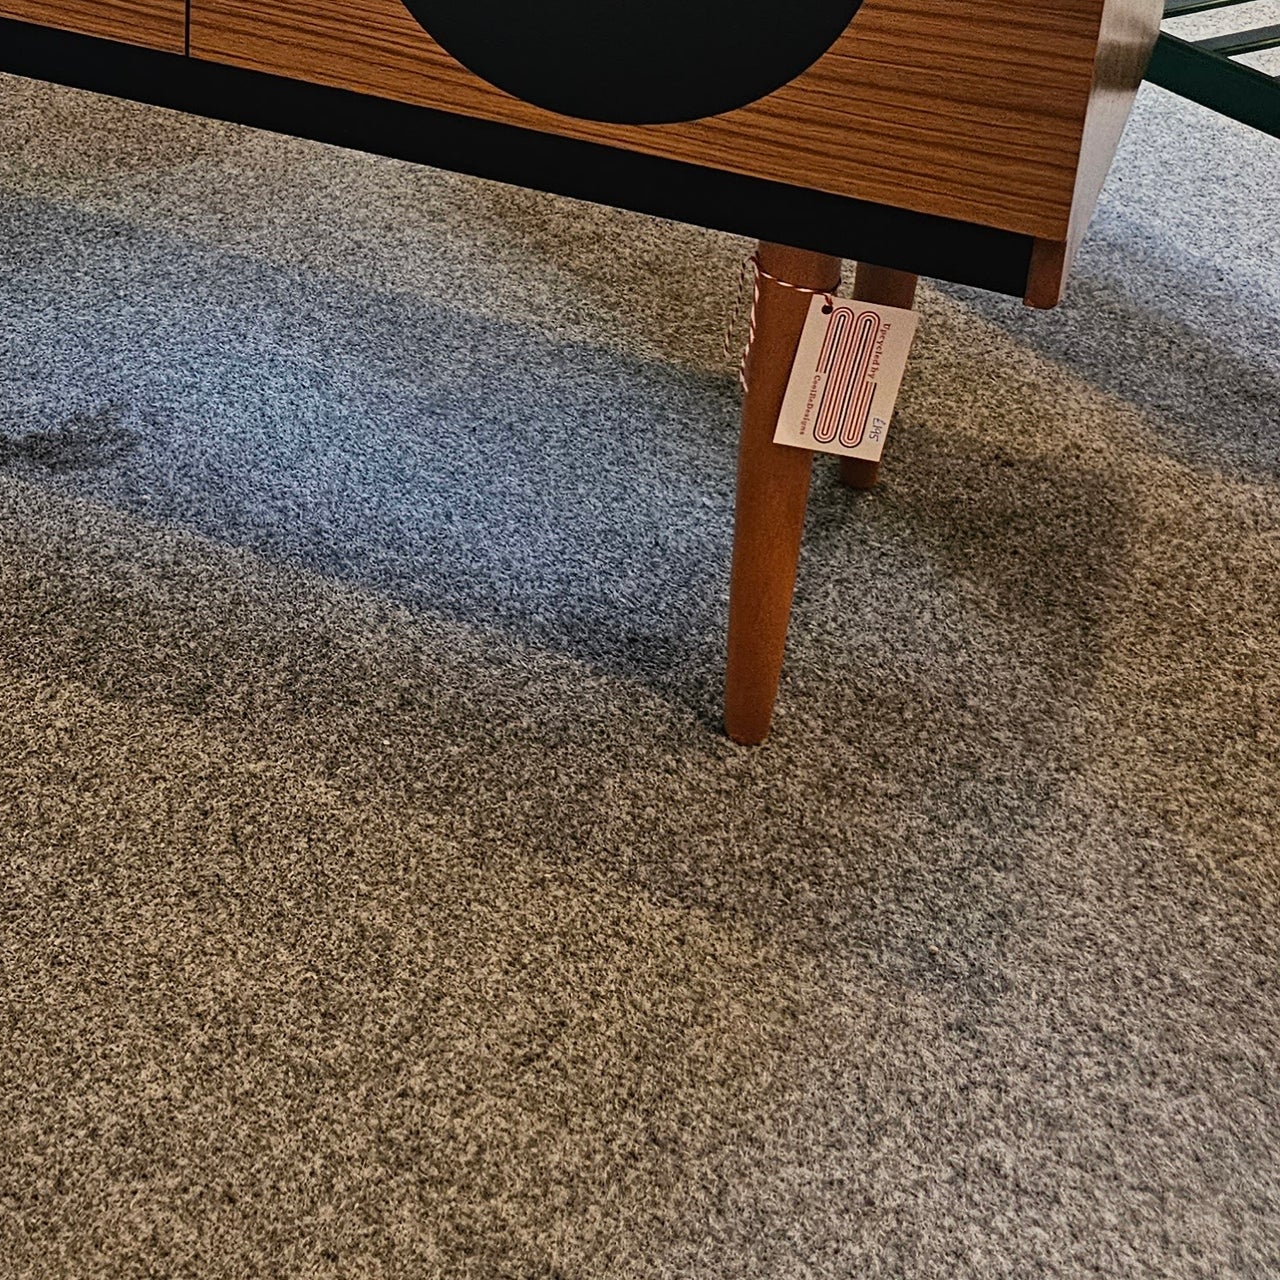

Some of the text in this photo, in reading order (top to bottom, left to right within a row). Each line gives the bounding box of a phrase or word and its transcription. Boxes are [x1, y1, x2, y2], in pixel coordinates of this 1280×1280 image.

[867, 323, 891, 381] Upcycled by
[869, 417, 886, 442] £195
